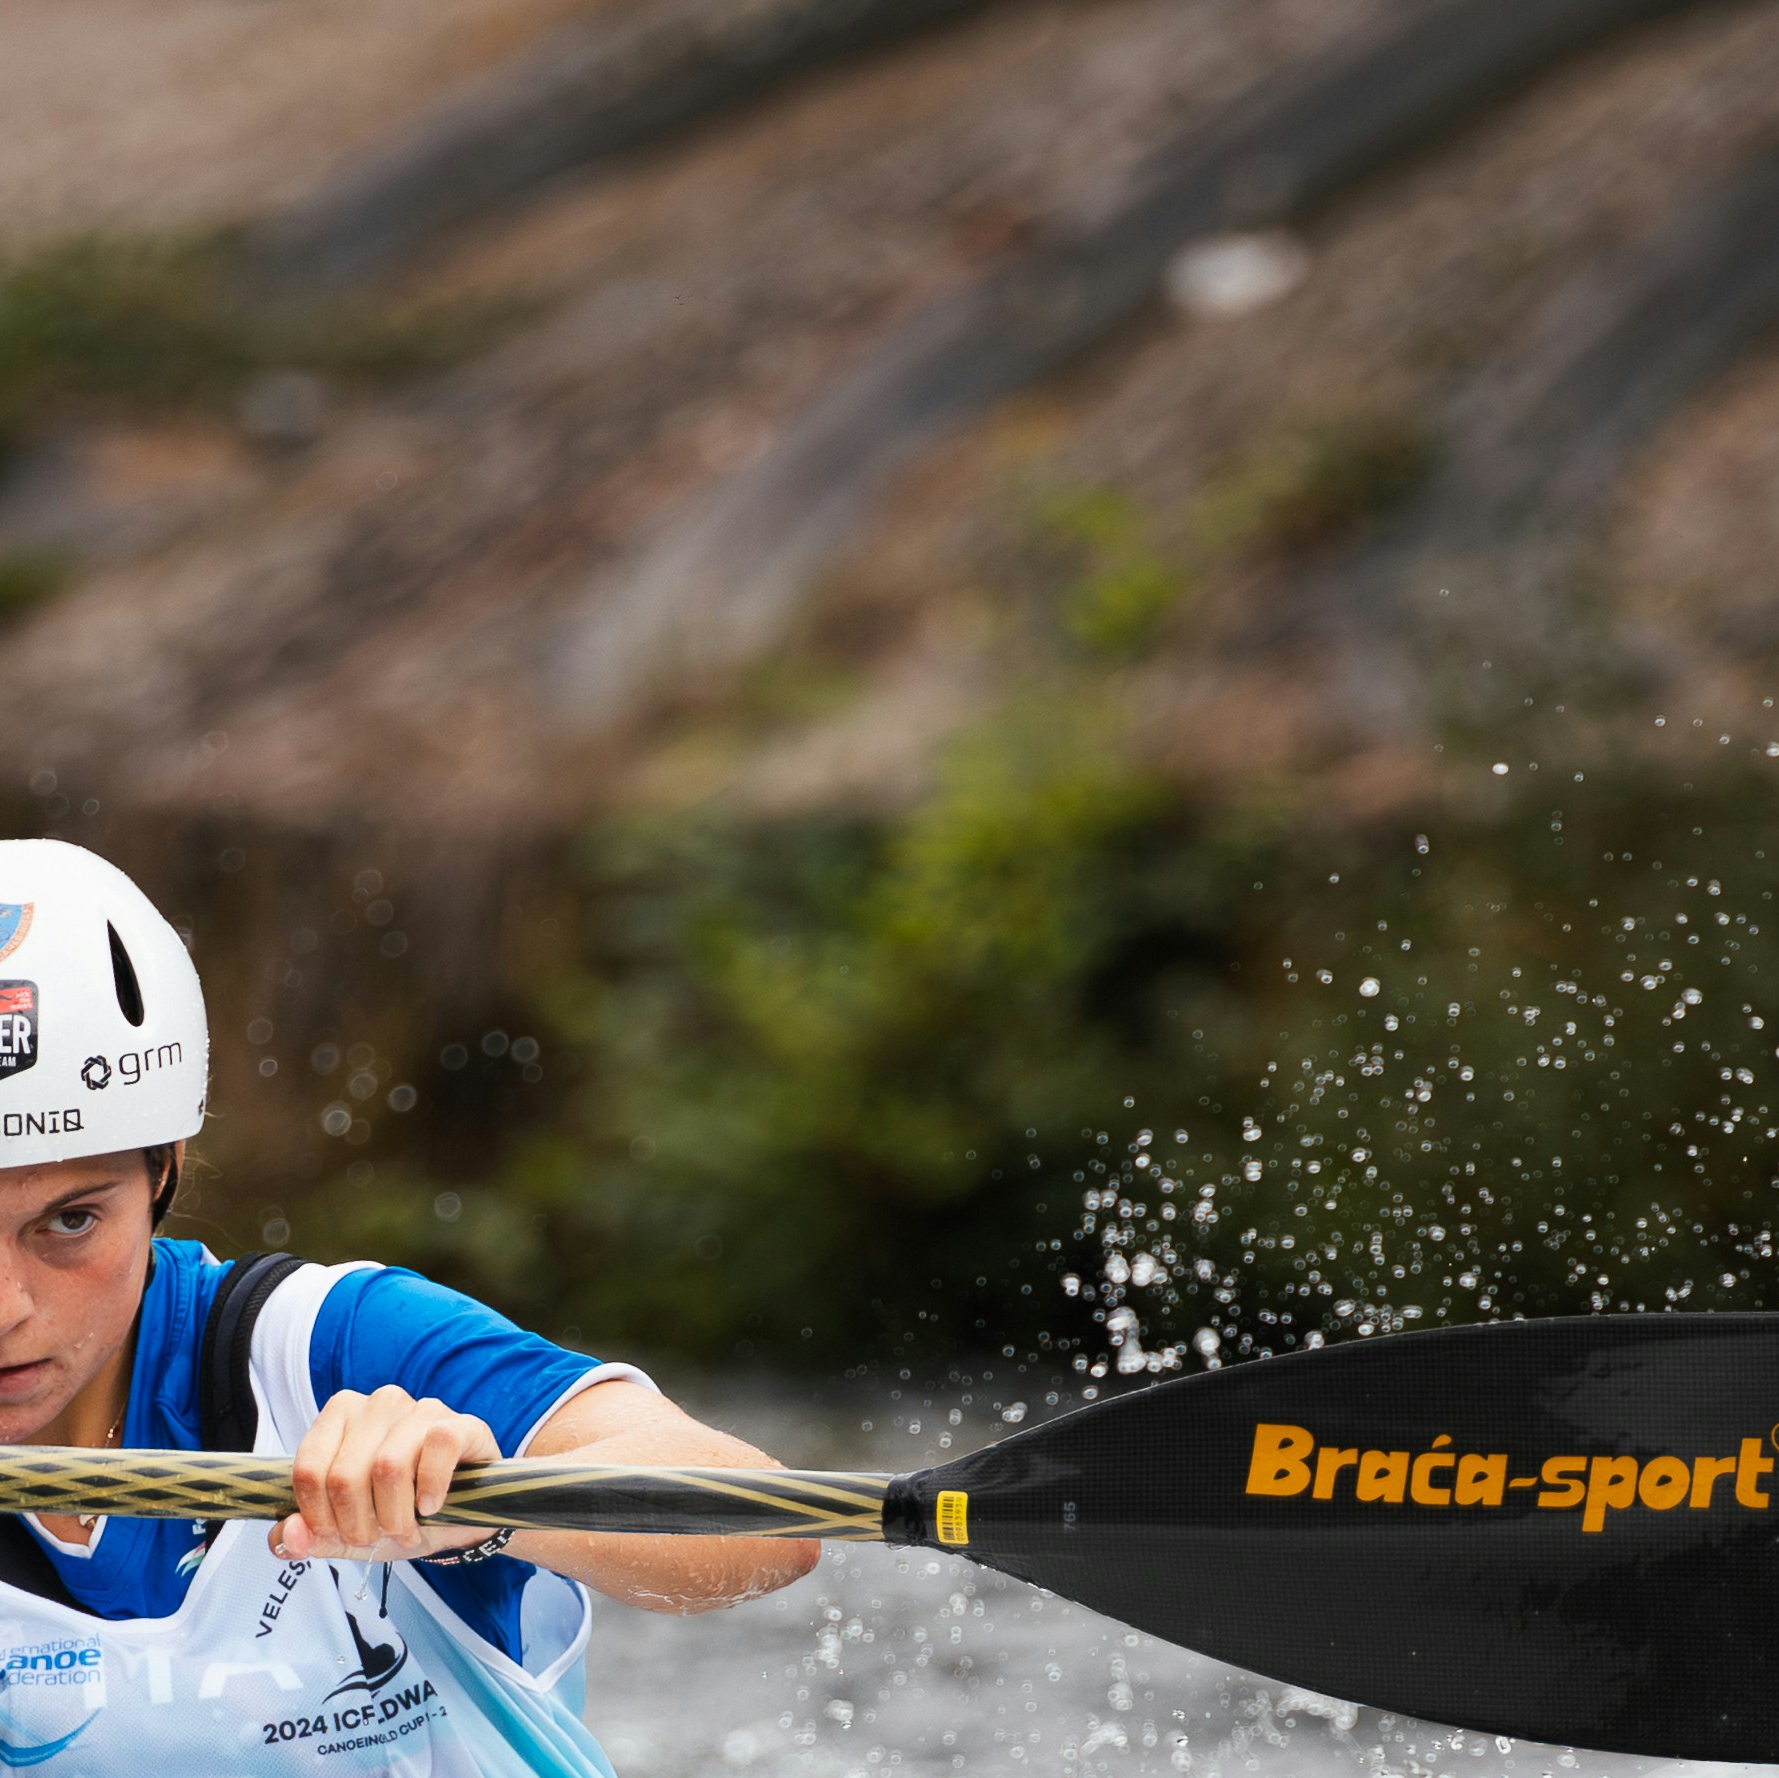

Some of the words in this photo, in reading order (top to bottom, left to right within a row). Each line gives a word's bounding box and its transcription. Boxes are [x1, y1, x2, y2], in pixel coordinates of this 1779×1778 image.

[119, 1042, 182, 1085] grm
[263, 1715, 328, 1744] 2024
[399, 1715, 426, 1735] CUP
